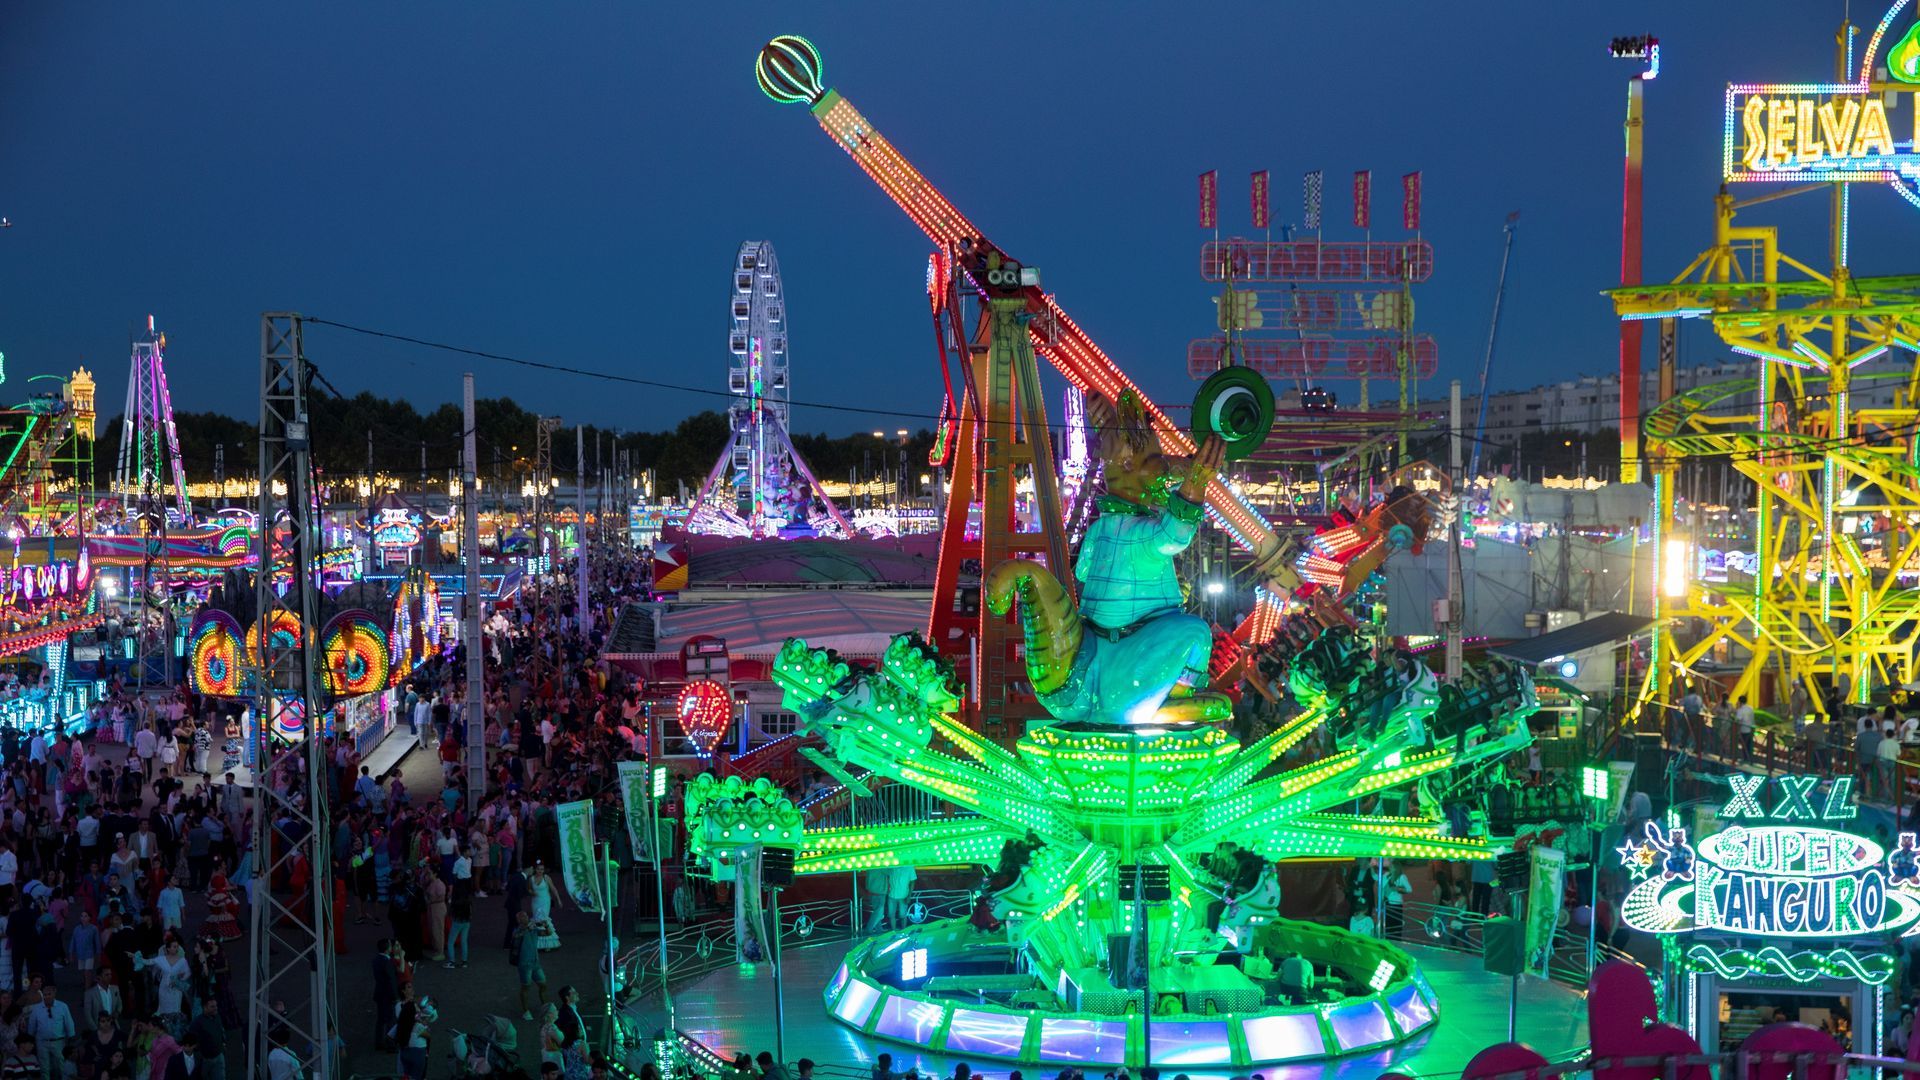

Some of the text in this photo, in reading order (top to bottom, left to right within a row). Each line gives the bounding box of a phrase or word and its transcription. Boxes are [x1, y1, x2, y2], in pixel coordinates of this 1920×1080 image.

[1742, 94, 1895, 171] SELVA
[682, 696, 721, 715] FLIP
[689, 709, 722, 728] FLY
[1717, 774, 1857, 819] XXL
[1717, 826, 1857, 874] SUPER
[1695, 860, 1887, 934] KANGURO
